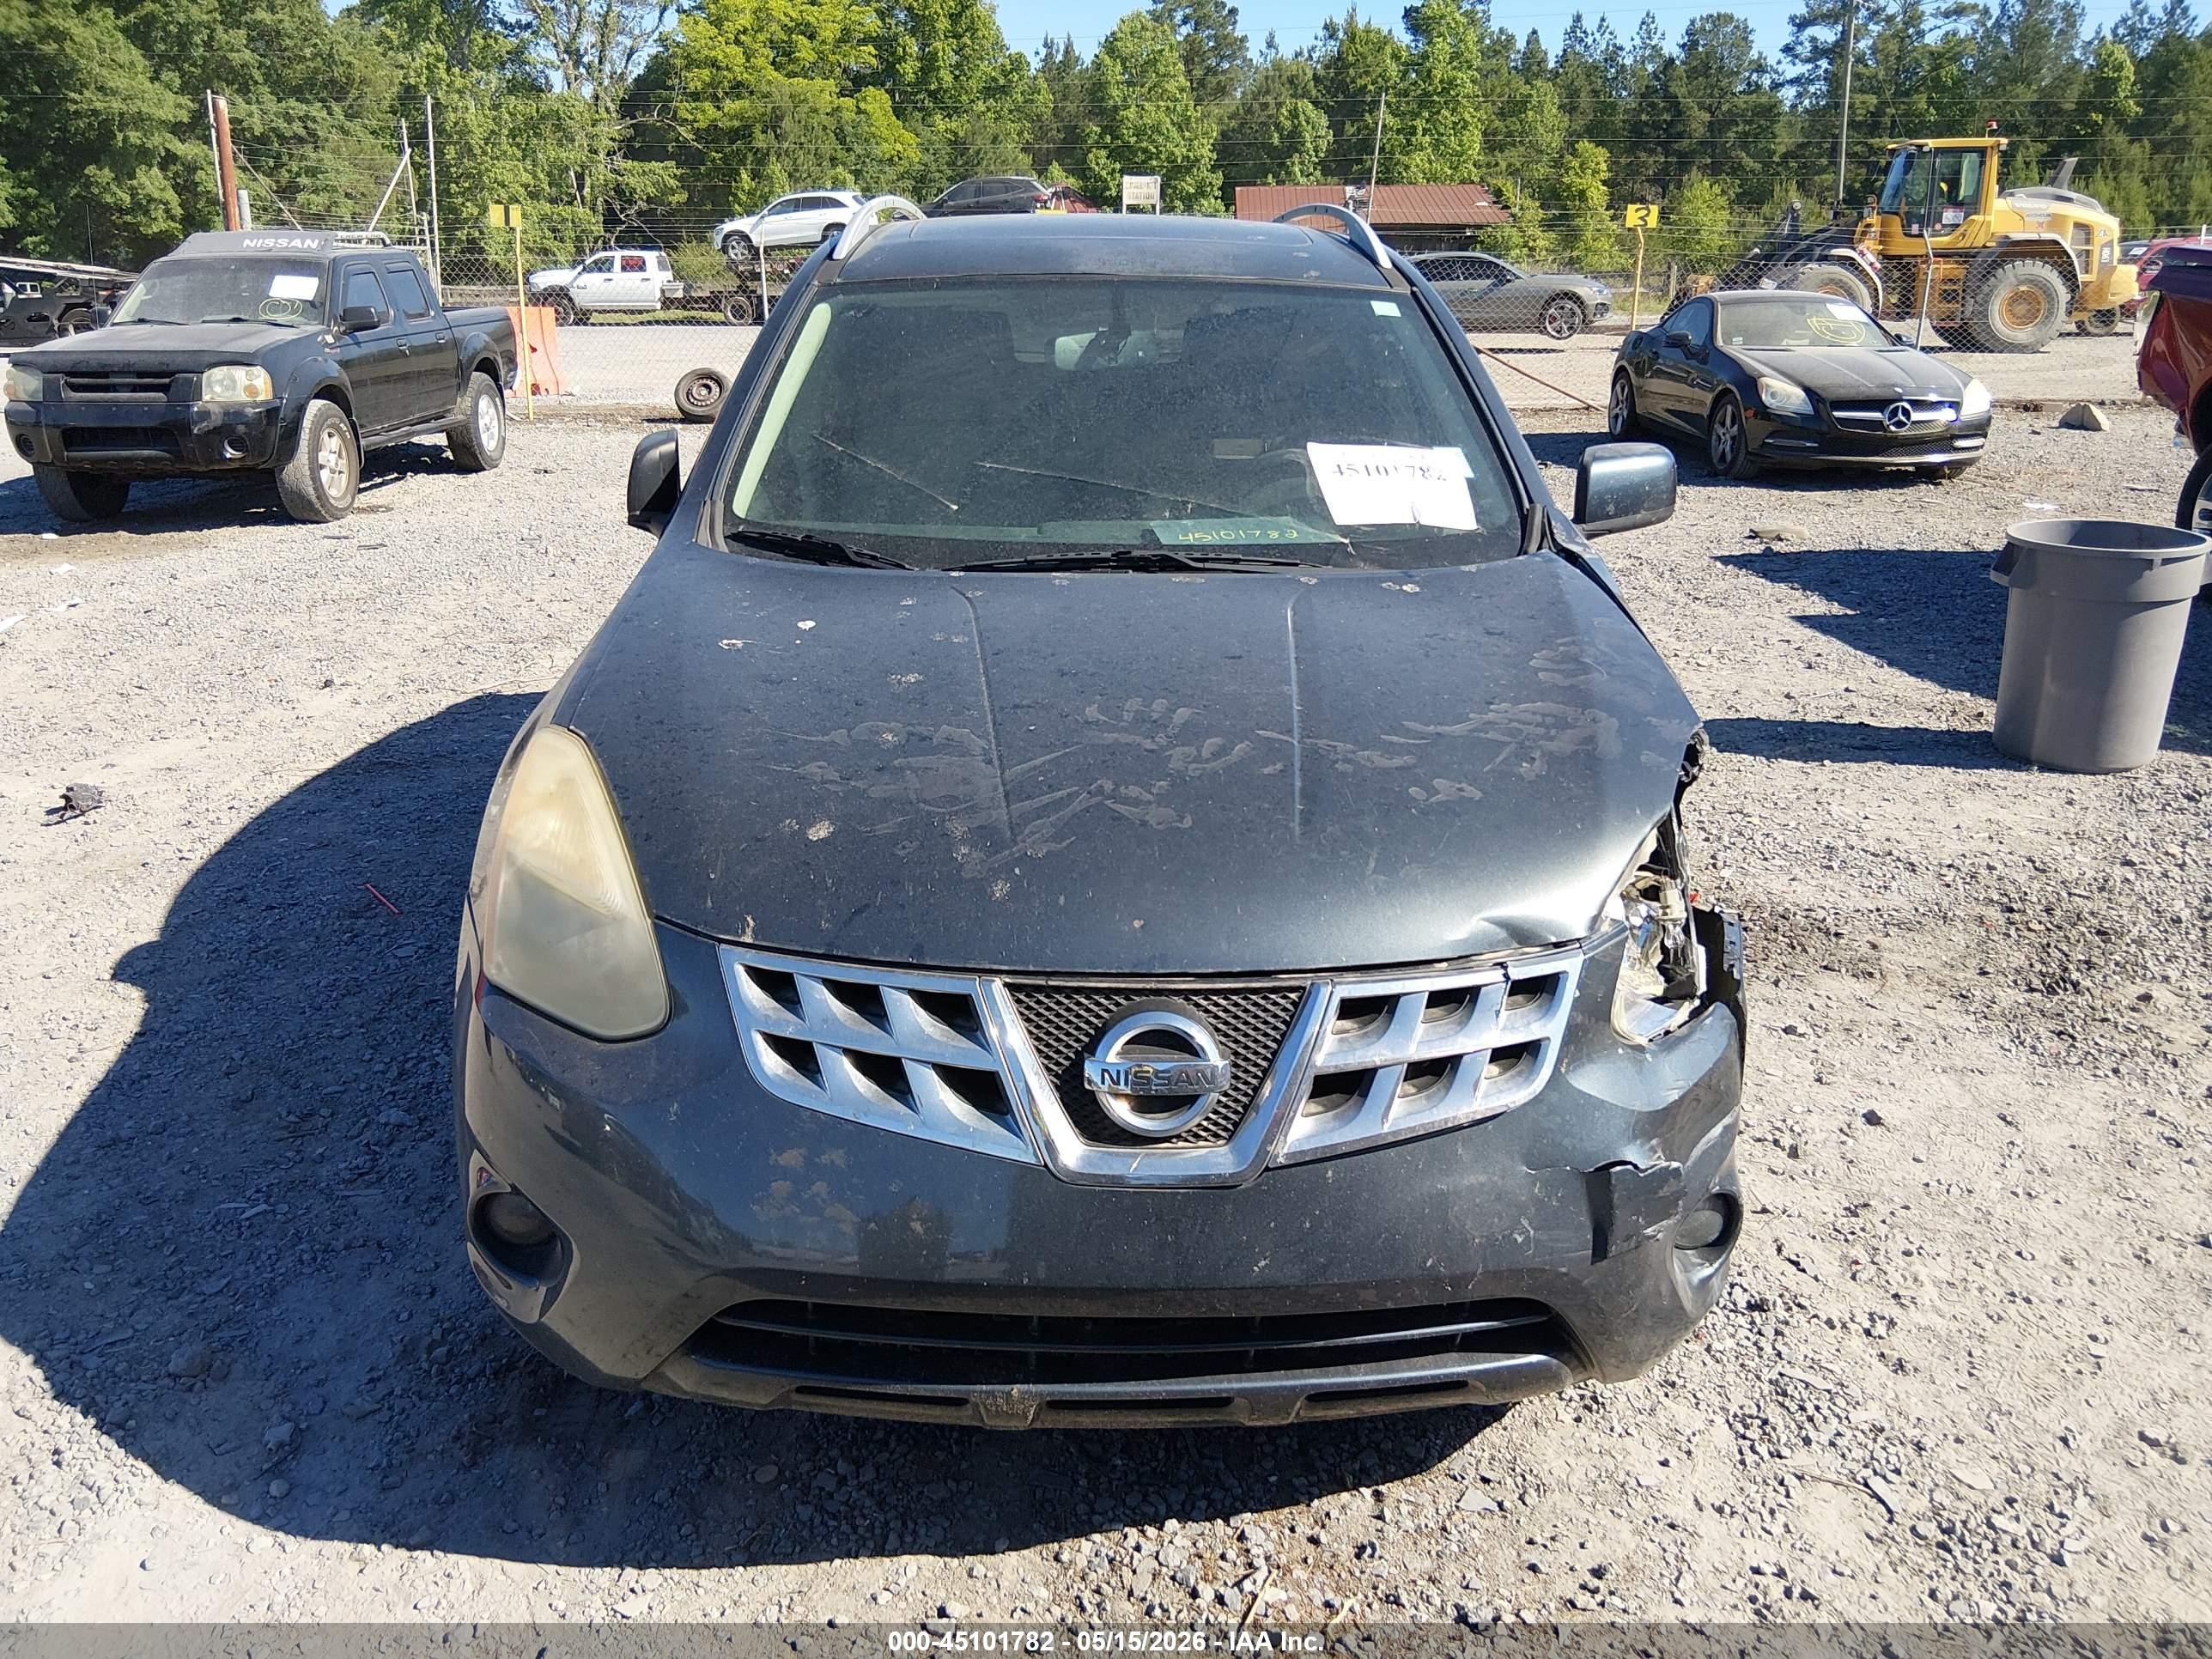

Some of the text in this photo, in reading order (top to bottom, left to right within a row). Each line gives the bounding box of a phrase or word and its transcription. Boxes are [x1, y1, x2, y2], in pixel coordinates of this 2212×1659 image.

[1633, 206, 1651, 227] 3
[242, 238, 319, 249] NISSAN
[1178, 528, 1299, 543] 45101782
[1099, 1066, 1217, 1089] NISSAN
